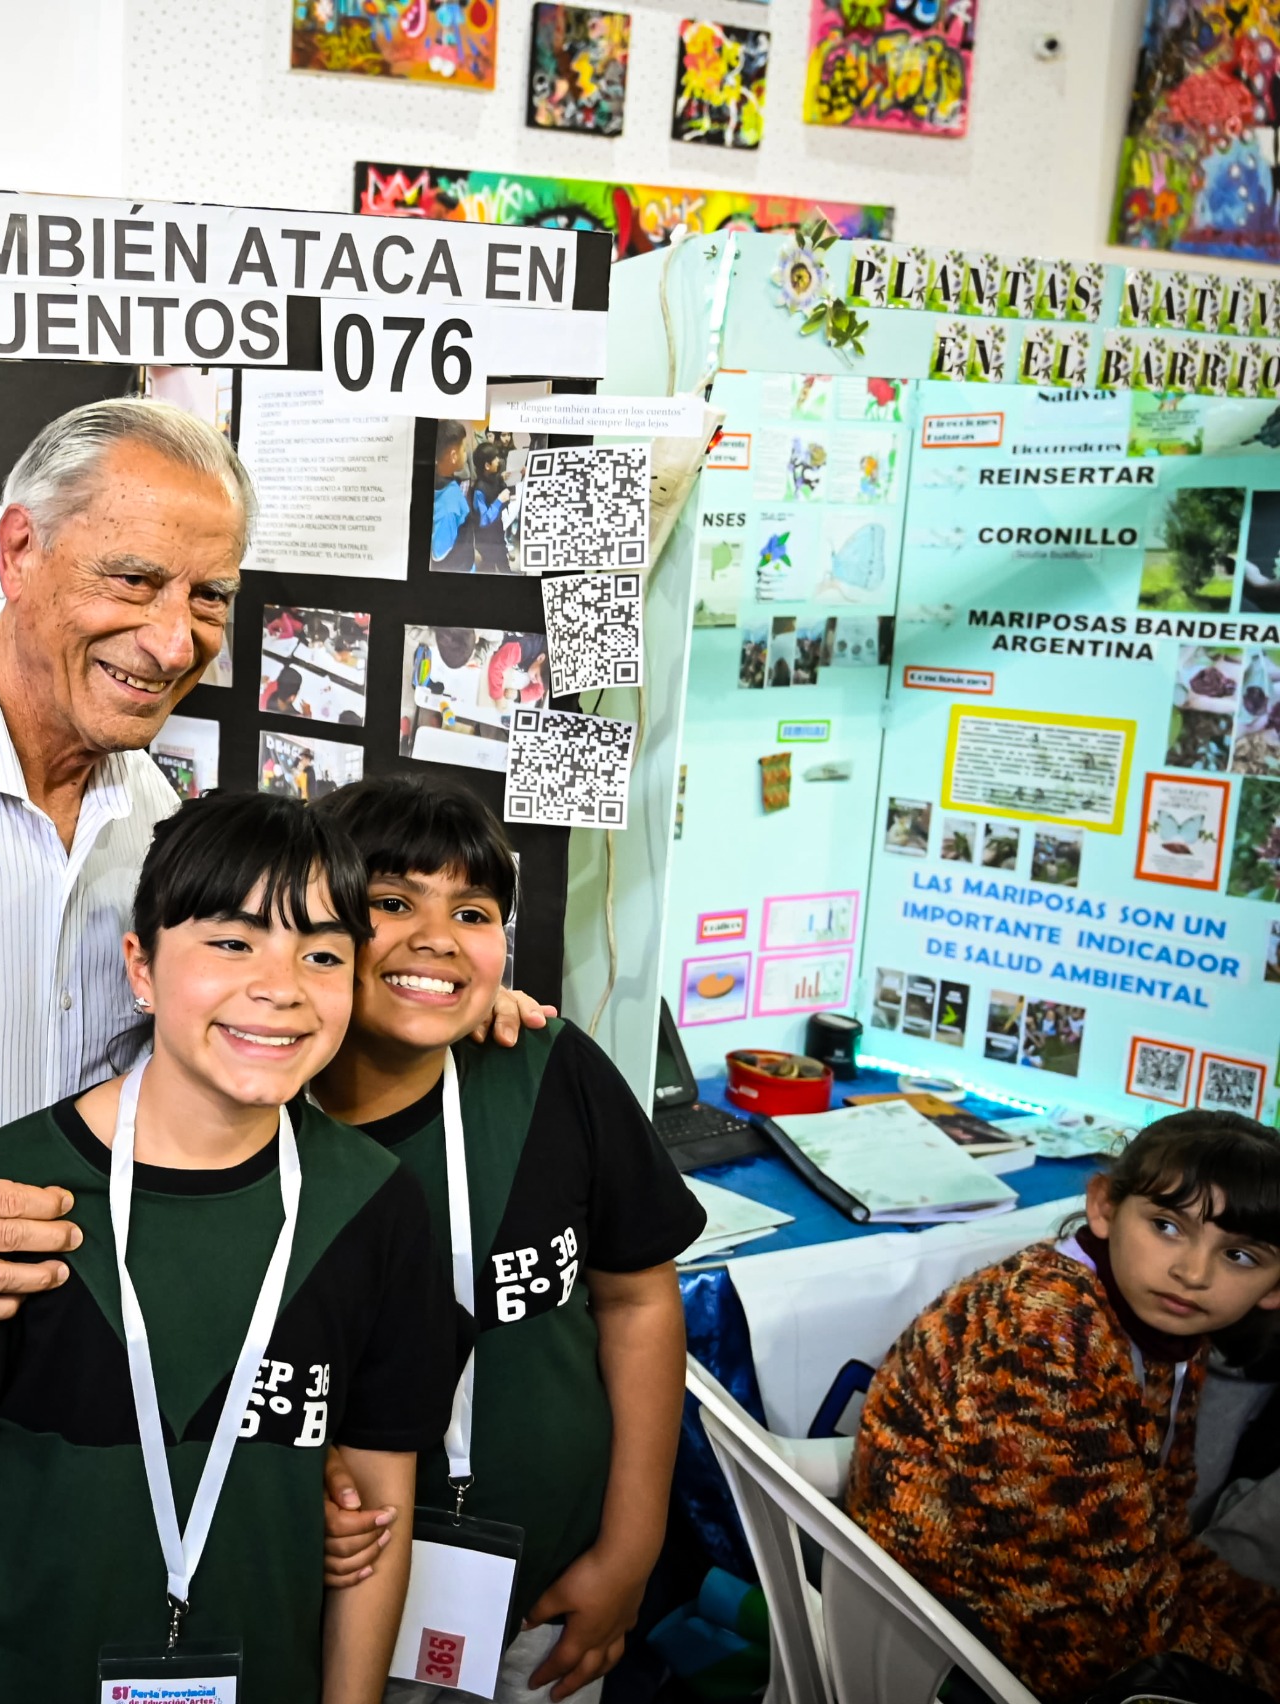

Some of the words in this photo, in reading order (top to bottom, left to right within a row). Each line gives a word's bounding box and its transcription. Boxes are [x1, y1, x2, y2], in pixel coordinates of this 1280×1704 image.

[229, 227, 463, 297] ATACA
[485, 242, 567, 302] EN
[852, 257, 1093, 310] PLANTAS
[333, 313, 474, 395] 076
[934, 336, 995, 375] EN
[1022, 341, 1075, 379] EL
[521, 402, 552, 413] dengue
[554, 404, 590, 414] también
[978, 465, 1156, 486] REINSERTAR
[703, 513, 746, 527] NSES
[978, 527, 1139, 546] CORONILLO
[968, 609, 1128, 634] MARIPOSAS
[1134, 617, 1280, 644] BANDERA
[992, 634, 1155, 661] ARGENTINA
[912, 871, 953, 895] LAS
[962, 878, 1107, 920] MARIPOSAS
[1118, 905, 1175, 932] SON
[1183, 916, 1228, 940] UN
[901, 900, 1062, 946] IMPORTANTE
[1077, 930, 1241, 978] INDICADOR
[925, 937, 957, 960] DE
[963, 944, 1043, 975] SALUD
[1049, 961, 1211, 1009] AMBIENTAL
[491, 1245, 539, 1285] EP
[550, 1226, 578, 1267] 38
[557, 1259, 579, 1307] B
[305, 1362, 330, 1398] 38
[293, 1400, 328, 1447] B
[425, 1635, 457, 1680] 365
[131, 1688, 160, 1699] Feria
[161, 1686, 216, 1699] Provincial
